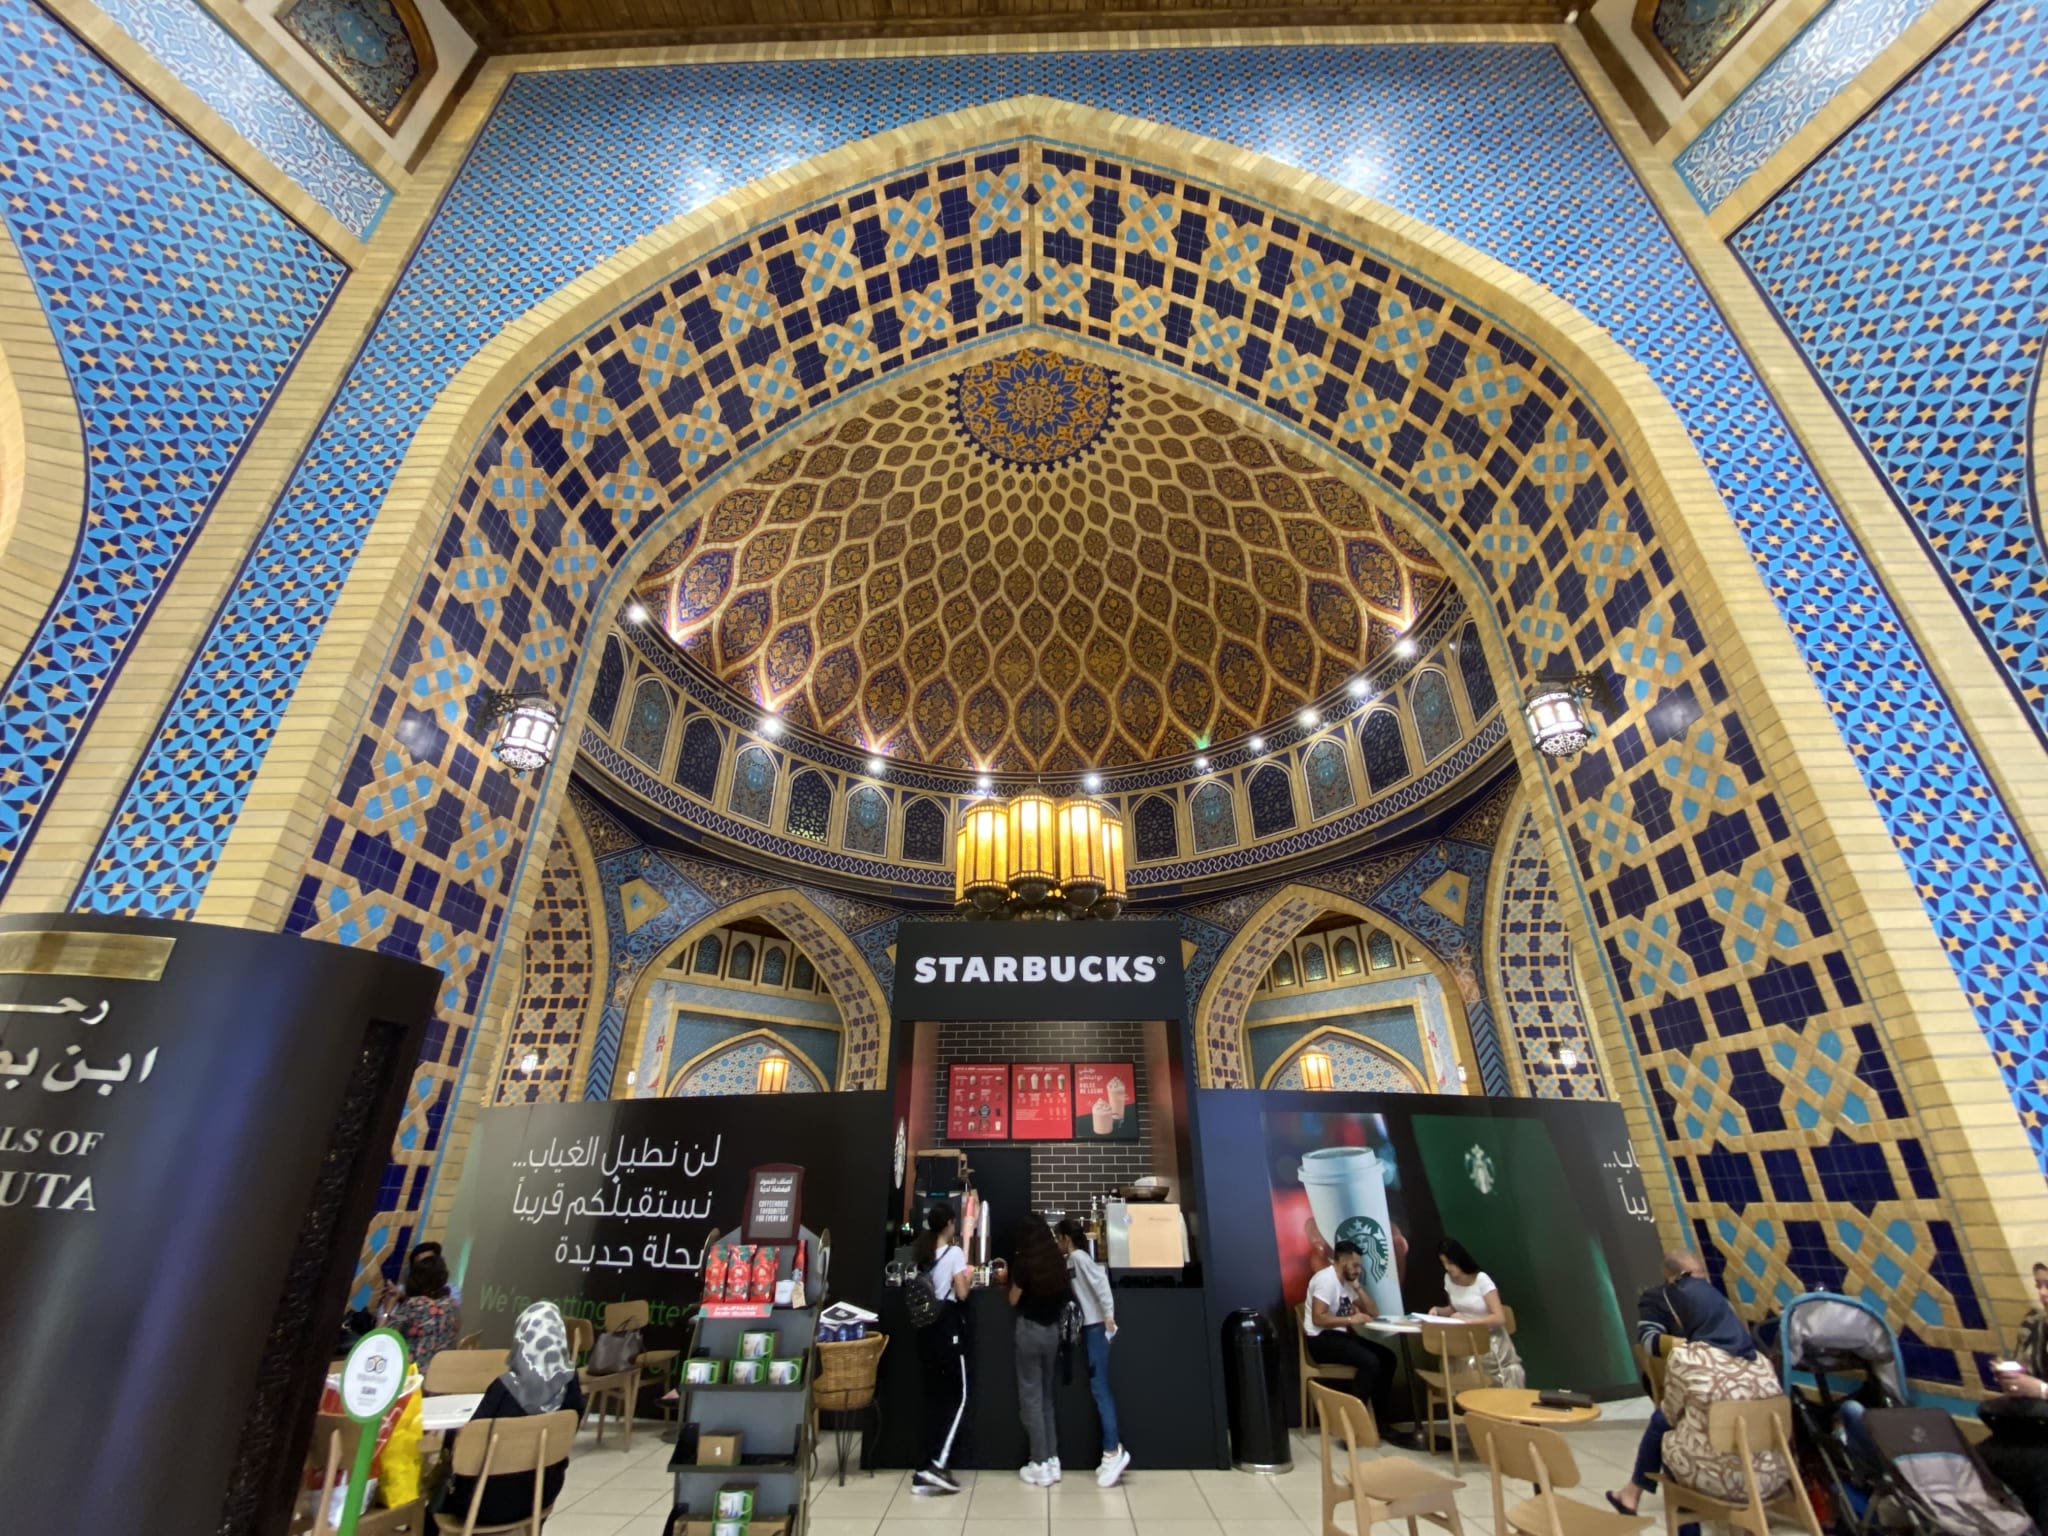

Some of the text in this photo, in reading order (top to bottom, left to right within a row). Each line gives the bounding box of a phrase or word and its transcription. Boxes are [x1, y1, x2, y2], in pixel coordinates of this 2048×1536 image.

[42, 1044, 160, 1097] ابن
[49, 1130, 105, 1156] OF
[601, 1134, 679, 1176] نطيل
[684, 1134, 721, 1177] لن
[565, 1183, 712, 1225] نستقبلكم
[555, 1233, 705, 1278] بحلة جديدة
